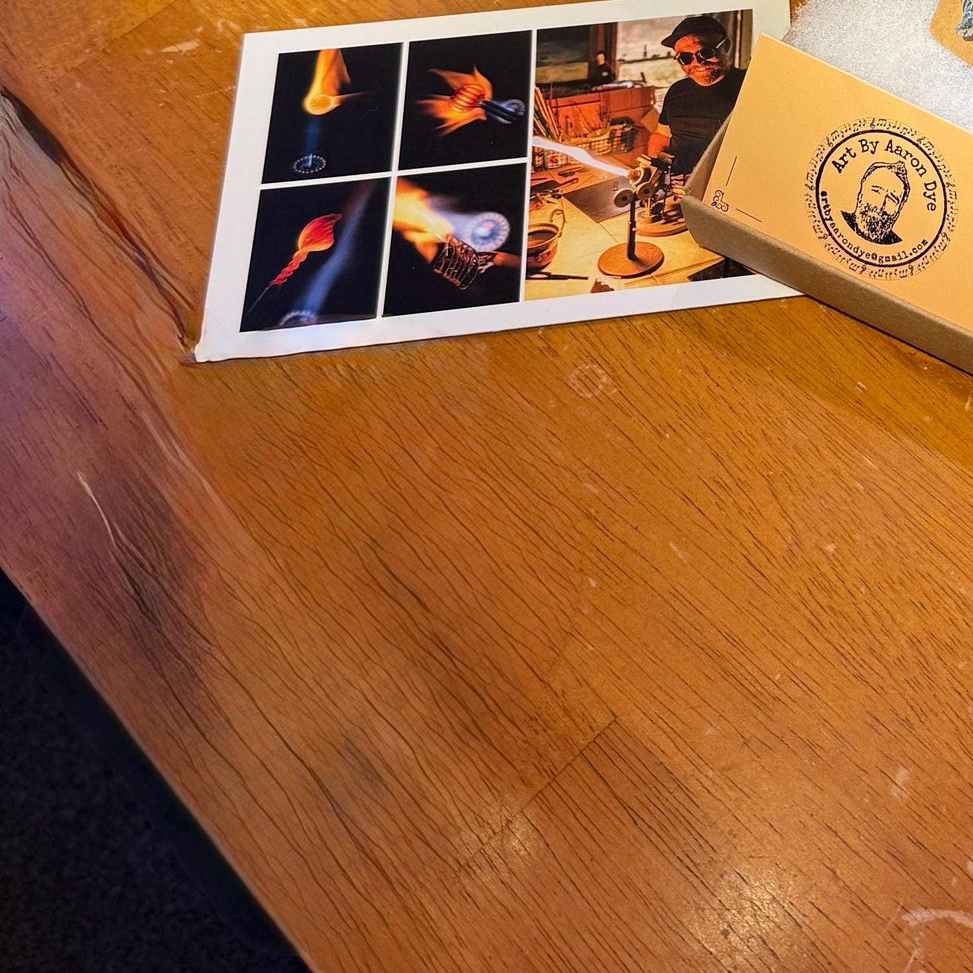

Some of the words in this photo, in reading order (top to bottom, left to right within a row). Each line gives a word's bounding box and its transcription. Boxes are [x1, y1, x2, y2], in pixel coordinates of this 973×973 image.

[831, 148, 856, 174] Art
[860, 139, 880, 157] By
[884, 139, 928, 179] Aaron
[921, 180, 938, 213] Dye
